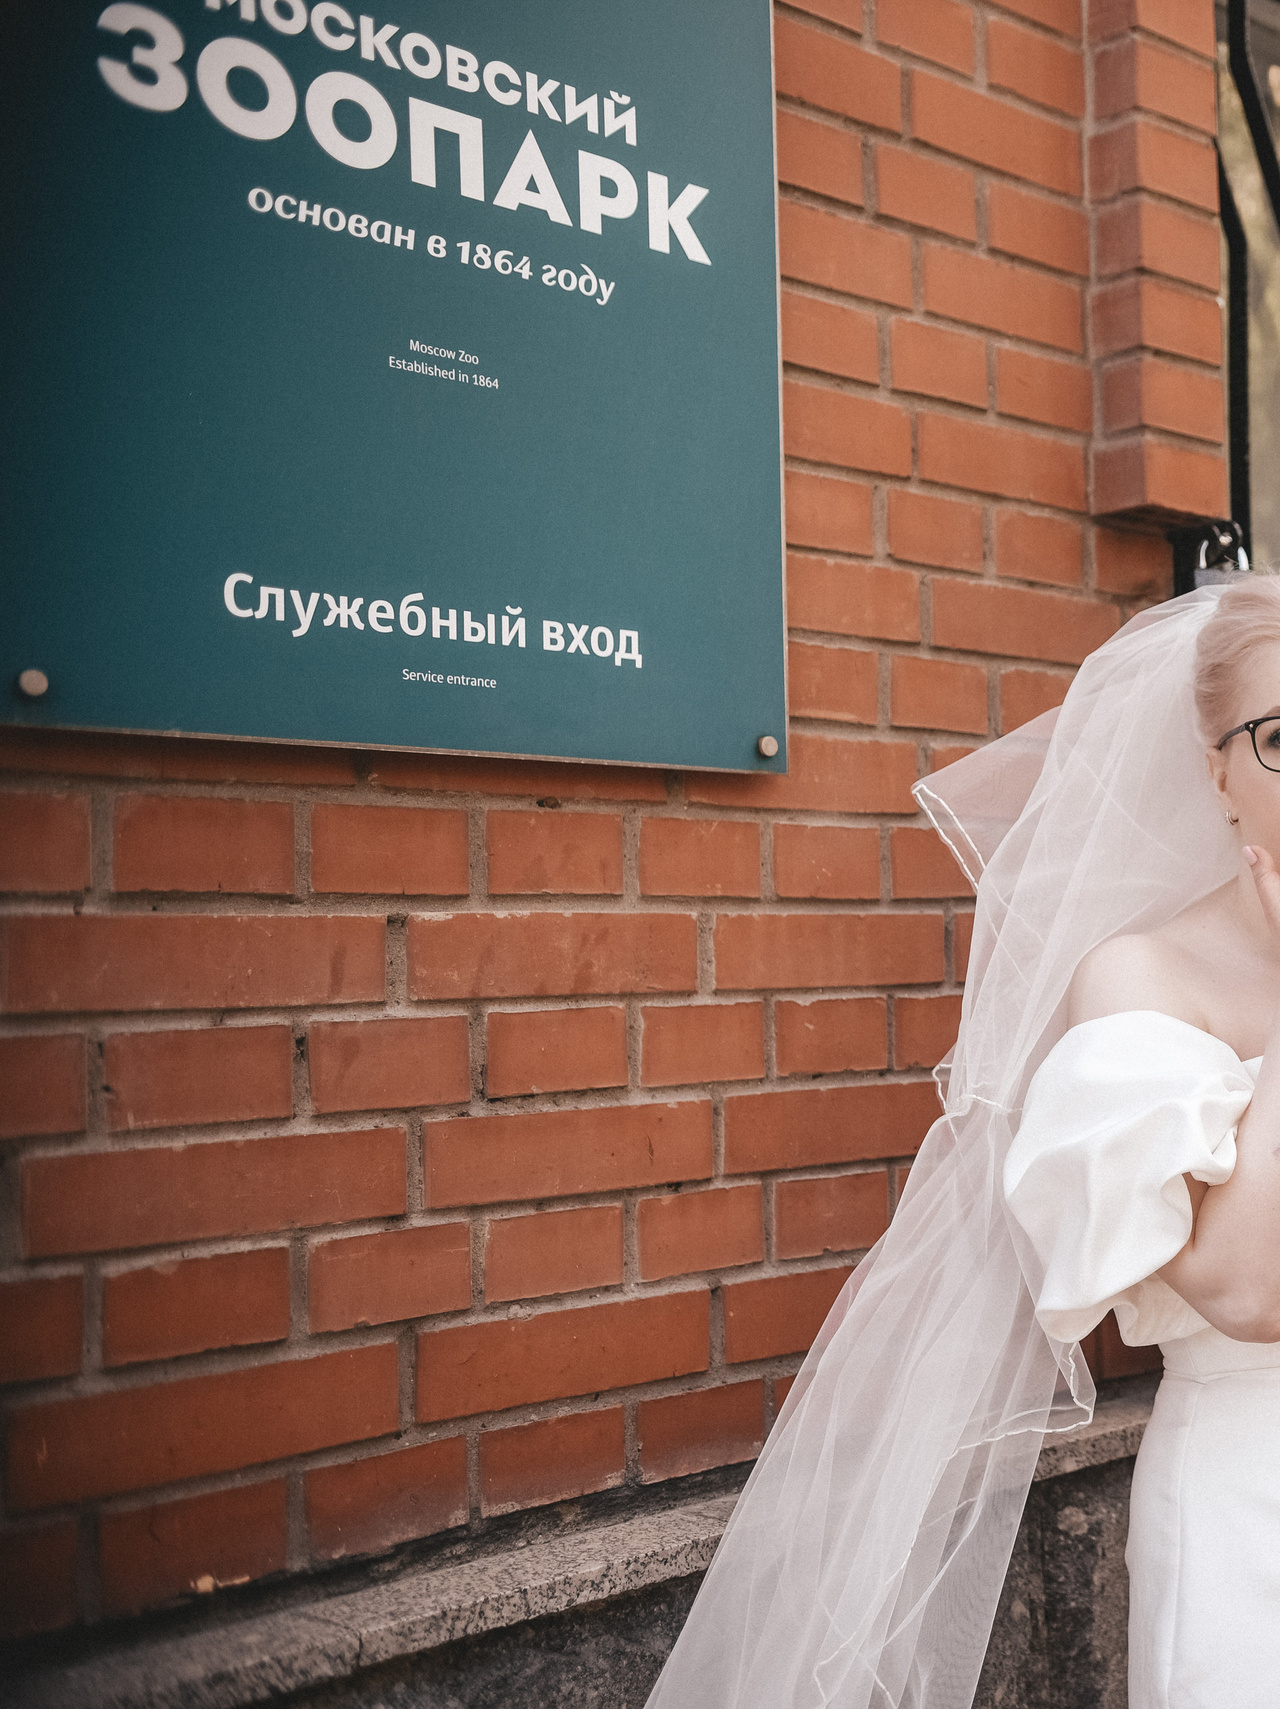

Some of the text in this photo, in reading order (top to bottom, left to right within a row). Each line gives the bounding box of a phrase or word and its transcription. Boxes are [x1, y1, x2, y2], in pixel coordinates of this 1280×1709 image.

[96, 2, 712, 266] ЗООПАРК
[247, 186, 617, 306] основан в 1864 году
[388, 355, 500, 390] Established in 1864
[409, 339, 480, 365] Moscow Zoo
[223, 571, 643, 669] Служебный вход
[402, 668, 497, 689] Service entrance
